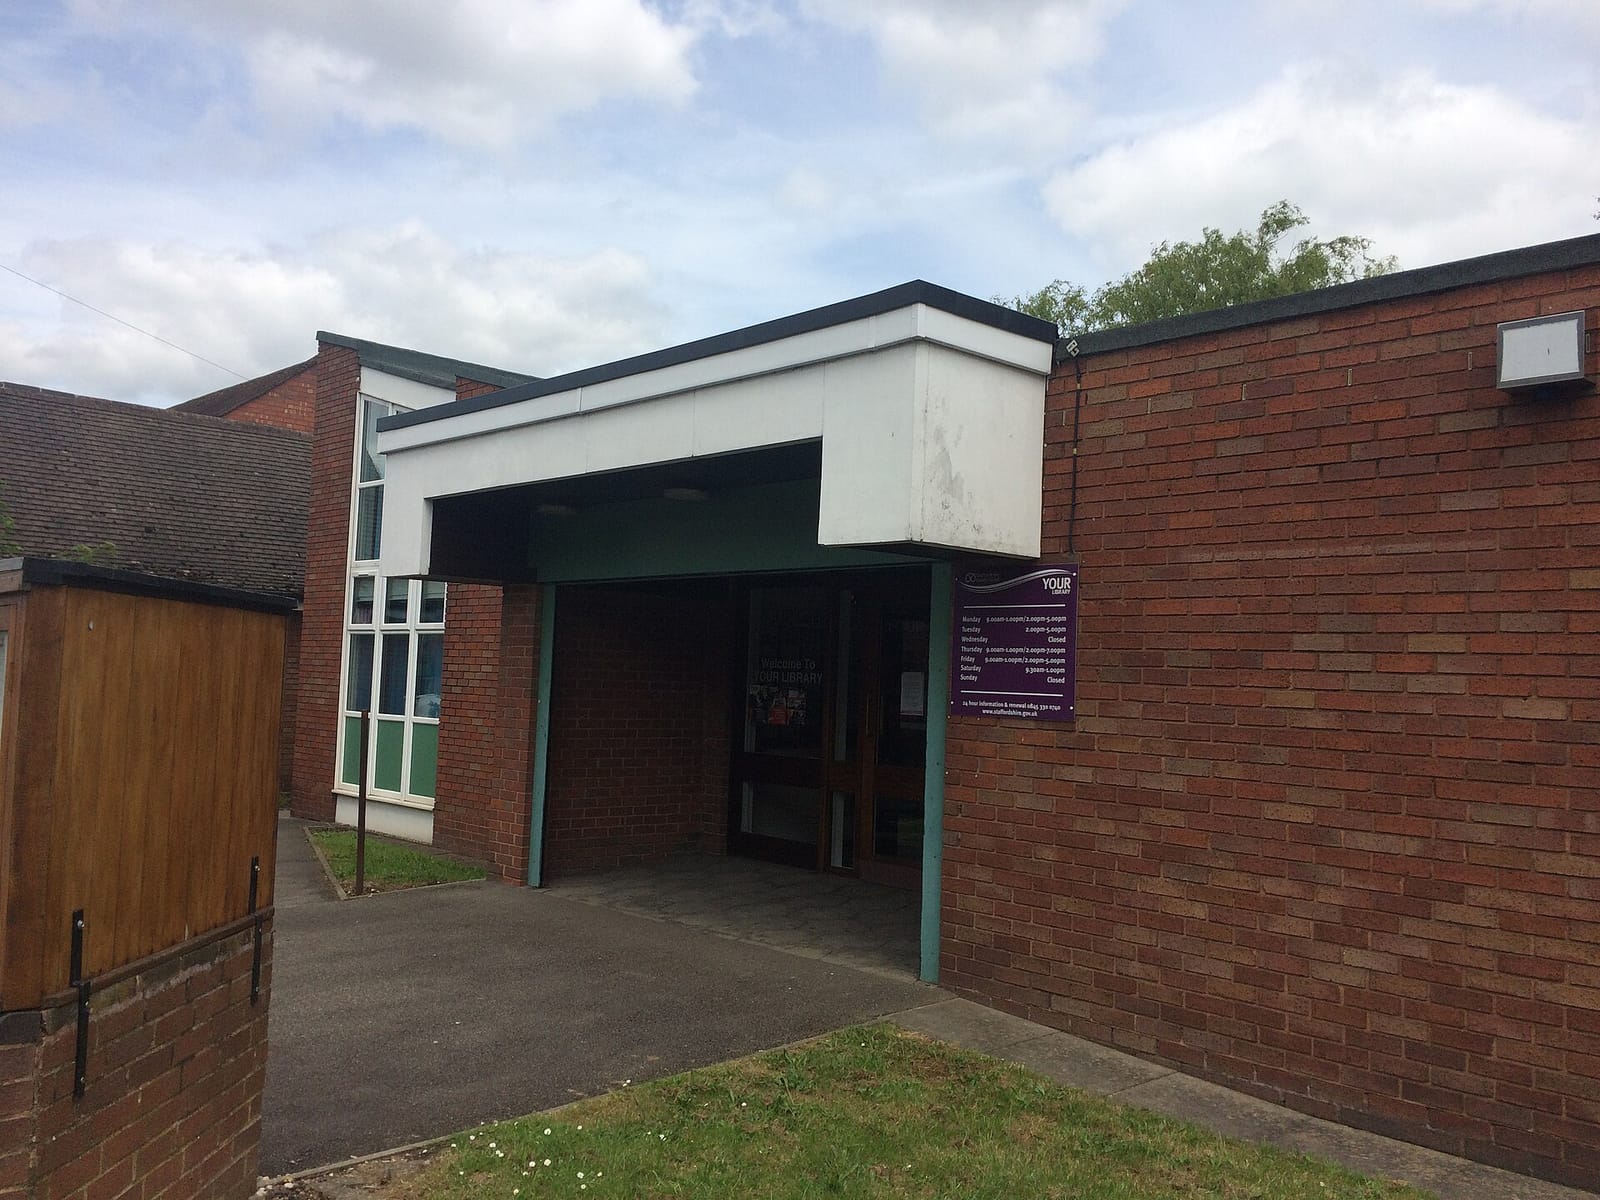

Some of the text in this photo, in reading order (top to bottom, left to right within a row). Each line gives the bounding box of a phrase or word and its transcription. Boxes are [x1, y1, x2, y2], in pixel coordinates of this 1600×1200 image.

[1042, 577, 1071, 590] YOUR
[961, 626, 981, 634] Tuesday
[961, 646, 983, 654] Thursday
[760, 656, 816, 671] Welcome To
[960, 655, 975, 663] Friday
[781, 671, 823, 686] LIBRARY
[960, 674, 1065, 684] Sunday Closed
